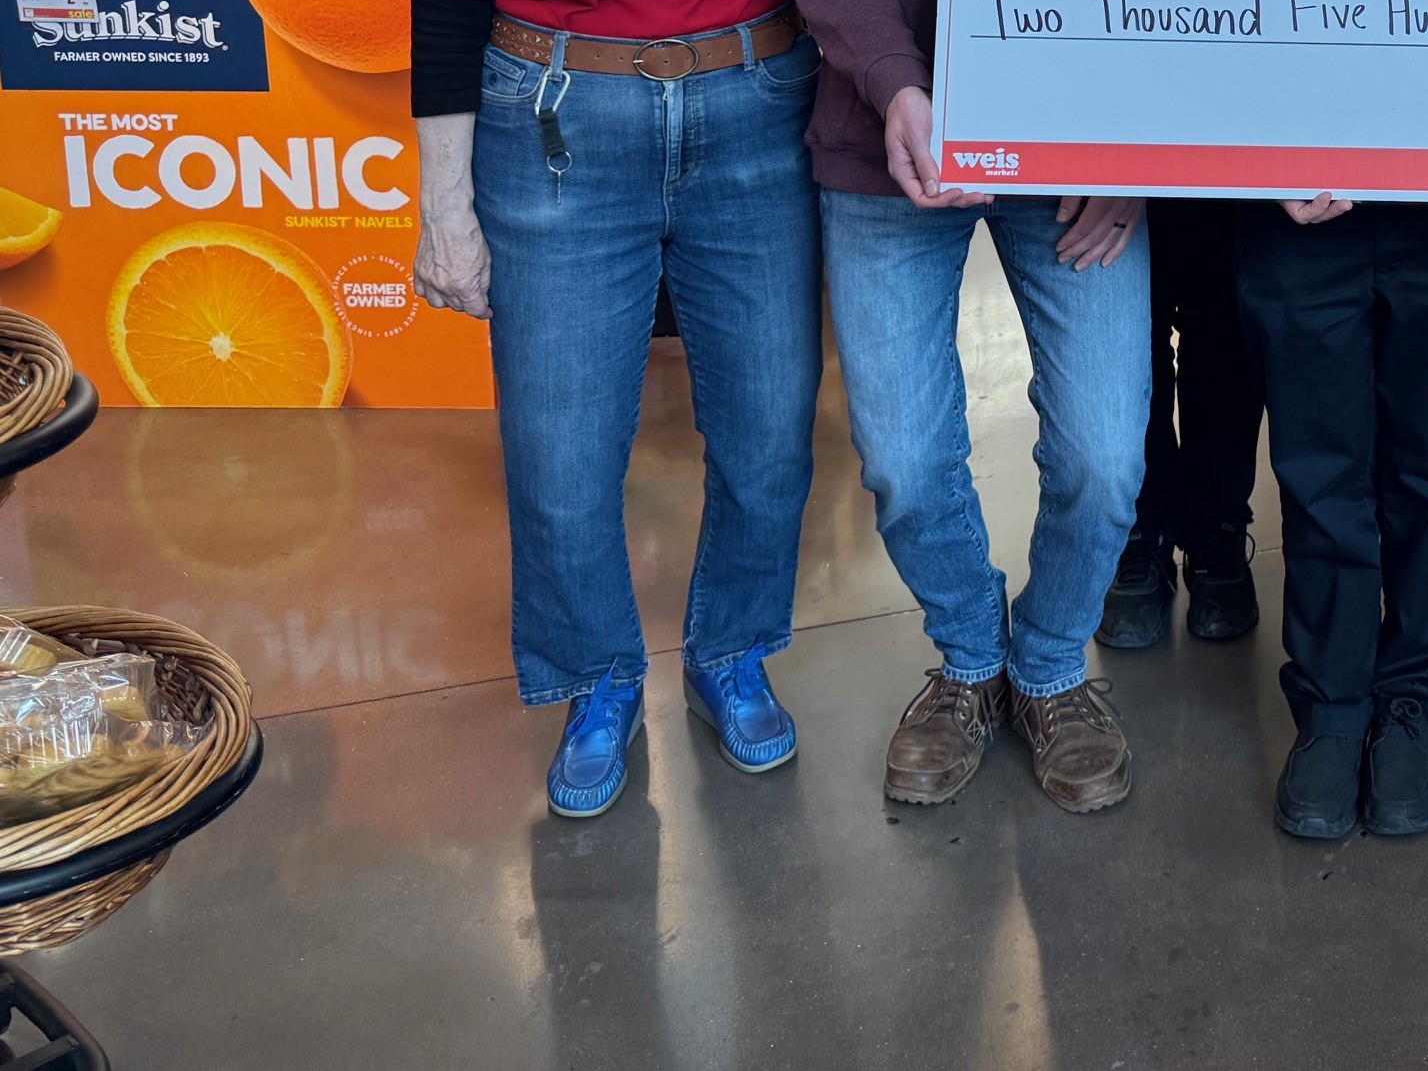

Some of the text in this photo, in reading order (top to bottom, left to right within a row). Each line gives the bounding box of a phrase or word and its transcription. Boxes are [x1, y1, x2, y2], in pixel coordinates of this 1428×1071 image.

[68, 9, 94, 19] sale
[31, 0, 226, 49] Sunkist
[54, 51, 210, 63] FARMER OWNED SINCE 1893
[59, 113, 179, 131] THE MOST
[952, 147, 1019, 169] weis
[64, 134, 411, 210] ICONIC
[285, 215, 413, 228] SUNKIST NAVELS
[343, 283, 407, 296] FARMER
[346, 295, 406, 308] OWNED
